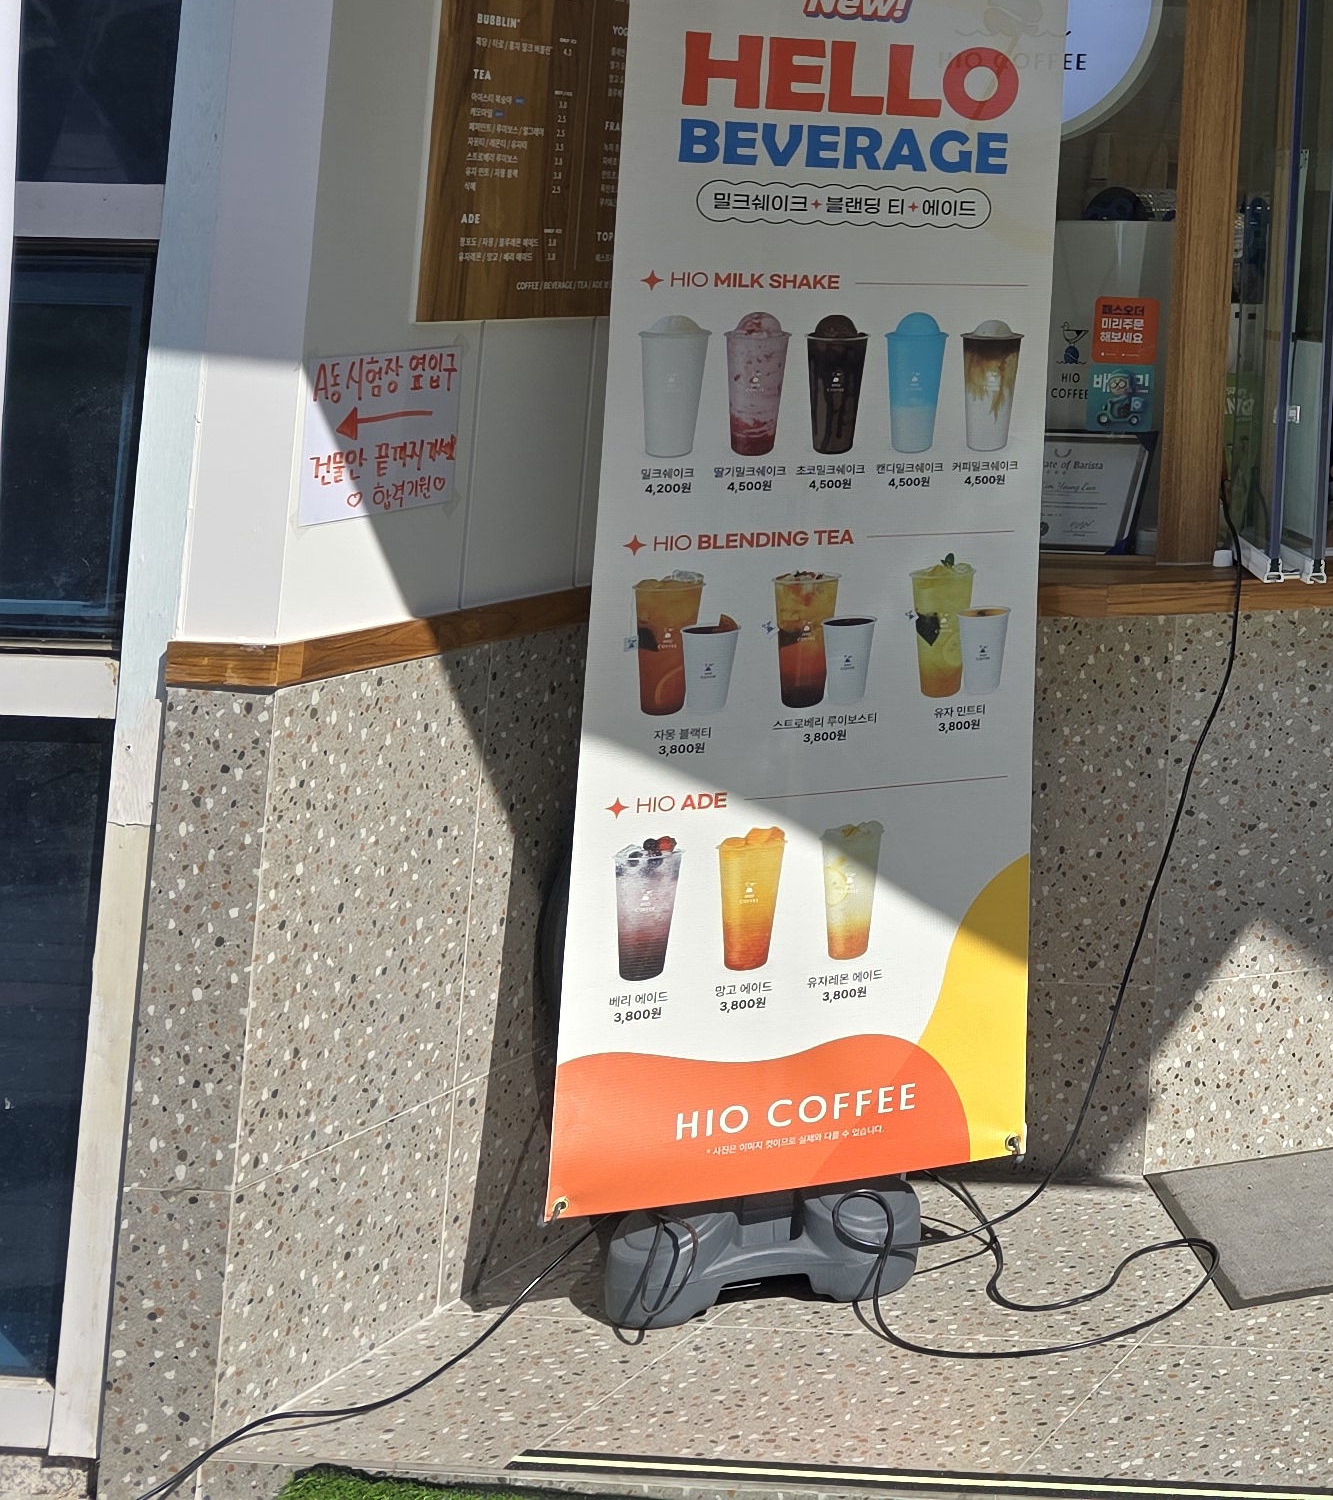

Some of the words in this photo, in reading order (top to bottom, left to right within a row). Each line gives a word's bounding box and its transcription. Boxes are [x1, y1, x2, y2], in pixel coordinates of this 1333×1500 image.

[473, 69, 491, 81] TEA
[681, 31, 1019, 121] HELLO
[678, 118, 1009, 175] BEVERAGE
[713, 192, 808, 213] 밀크쉐이크
[825, 195, 882, 215] 블랜딩
[888, 196, 905, 216] 티
[921, 198, 976, 217] 에이드
[461, 214, 480, 225] ADE
[670, 271, 709, 288] HIO
[714, 273, 764, 289] MILK
[769, 273, 840, 290] SHAKE
[1102, 318, 1144, 330] 미리주문
[1100, 332, 1143, 343] 해보세요
[313, 363, 341, 403] A동
[346, 355, 403, 401] 시험장
[1062, 373, 1080, 383] HIO
[1051, 388, 1088, 400] COFFEE
[310, 448, 368, 486] 건물안
[640, 466, 695, 480] 밀크쉐이크
[713, 465, 786, 479] 딸기밀크쉐이크
[795, 463, 866, 477] 초코밀크쉐이크
[727, 479, 773, 494] 4,500원
[808, 477, 852, 492] 4,500원
[888, 475, 930, 490] 4,500원
[964, 473, 1006, 488] 4,500원
[645, 481, 692, 496] 4,200원
[653, 534, 692, 552] HIO
[697, 530, 809, 550] BLENDING
[814, 529, 854, 546] TEA
[934, 706, 954, 719] 유자
[956, 704, 986, 717] 민트티
[773, 716, 824, 730] 스트로베리
[827, 712, 878, 728] 루이보스티
[938, 718, 980, 733] 3,800원
[653, 727, 675, 741] 자몽
[678, 726, 712, 740] 블랙티
[803, 728, 847, 744] 3,800원
[658, 741, 706, 757] 3,800원
[635, 795, 675, 814] HIO
[680, 792, 729, 810] ADE
[852, 968, 884, 984] 에이드
[715, 982, 737, 998] 망고
[739, 980, 773, 995] 에이드
[822, 985, 867, 1003] 3,800원
[609, 993, 632, 1008] 베리
[634, 990, 669, 1006] 에이드
[719, 996, 767, 1013] 3,800원
[613, 1006, 662, 1024] 3,800원
[674, 1104, 749, 1141] HIO
[766, 1082, 918, 1127] COFFEE
[739, 1141, 763, 1151] 이미지
